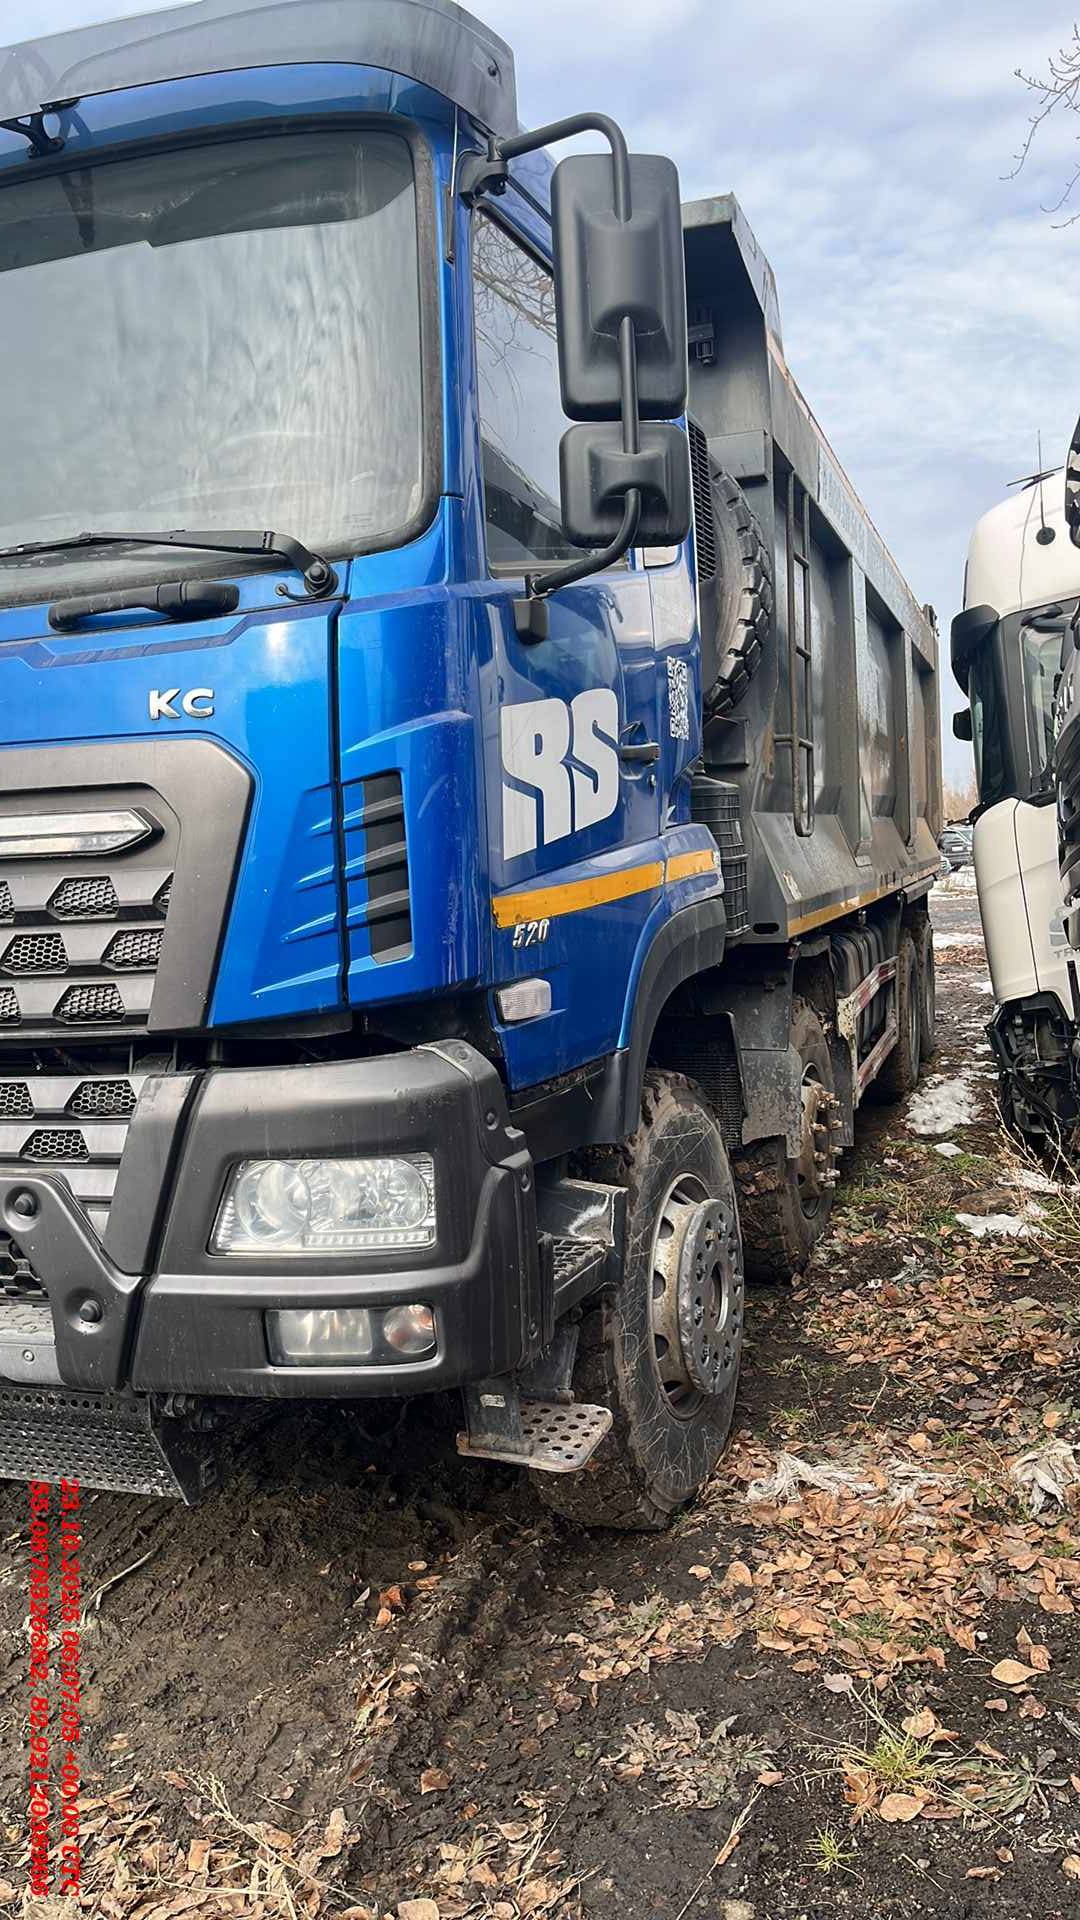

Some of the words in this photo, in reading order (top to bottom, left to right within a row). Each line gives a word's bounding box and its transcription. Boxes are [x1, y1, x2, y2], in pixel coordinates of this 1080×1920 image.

[149, 688, 214, 720] KC
[501, 688, 619, 860] RS
[512, 919, 550, 948] 520
